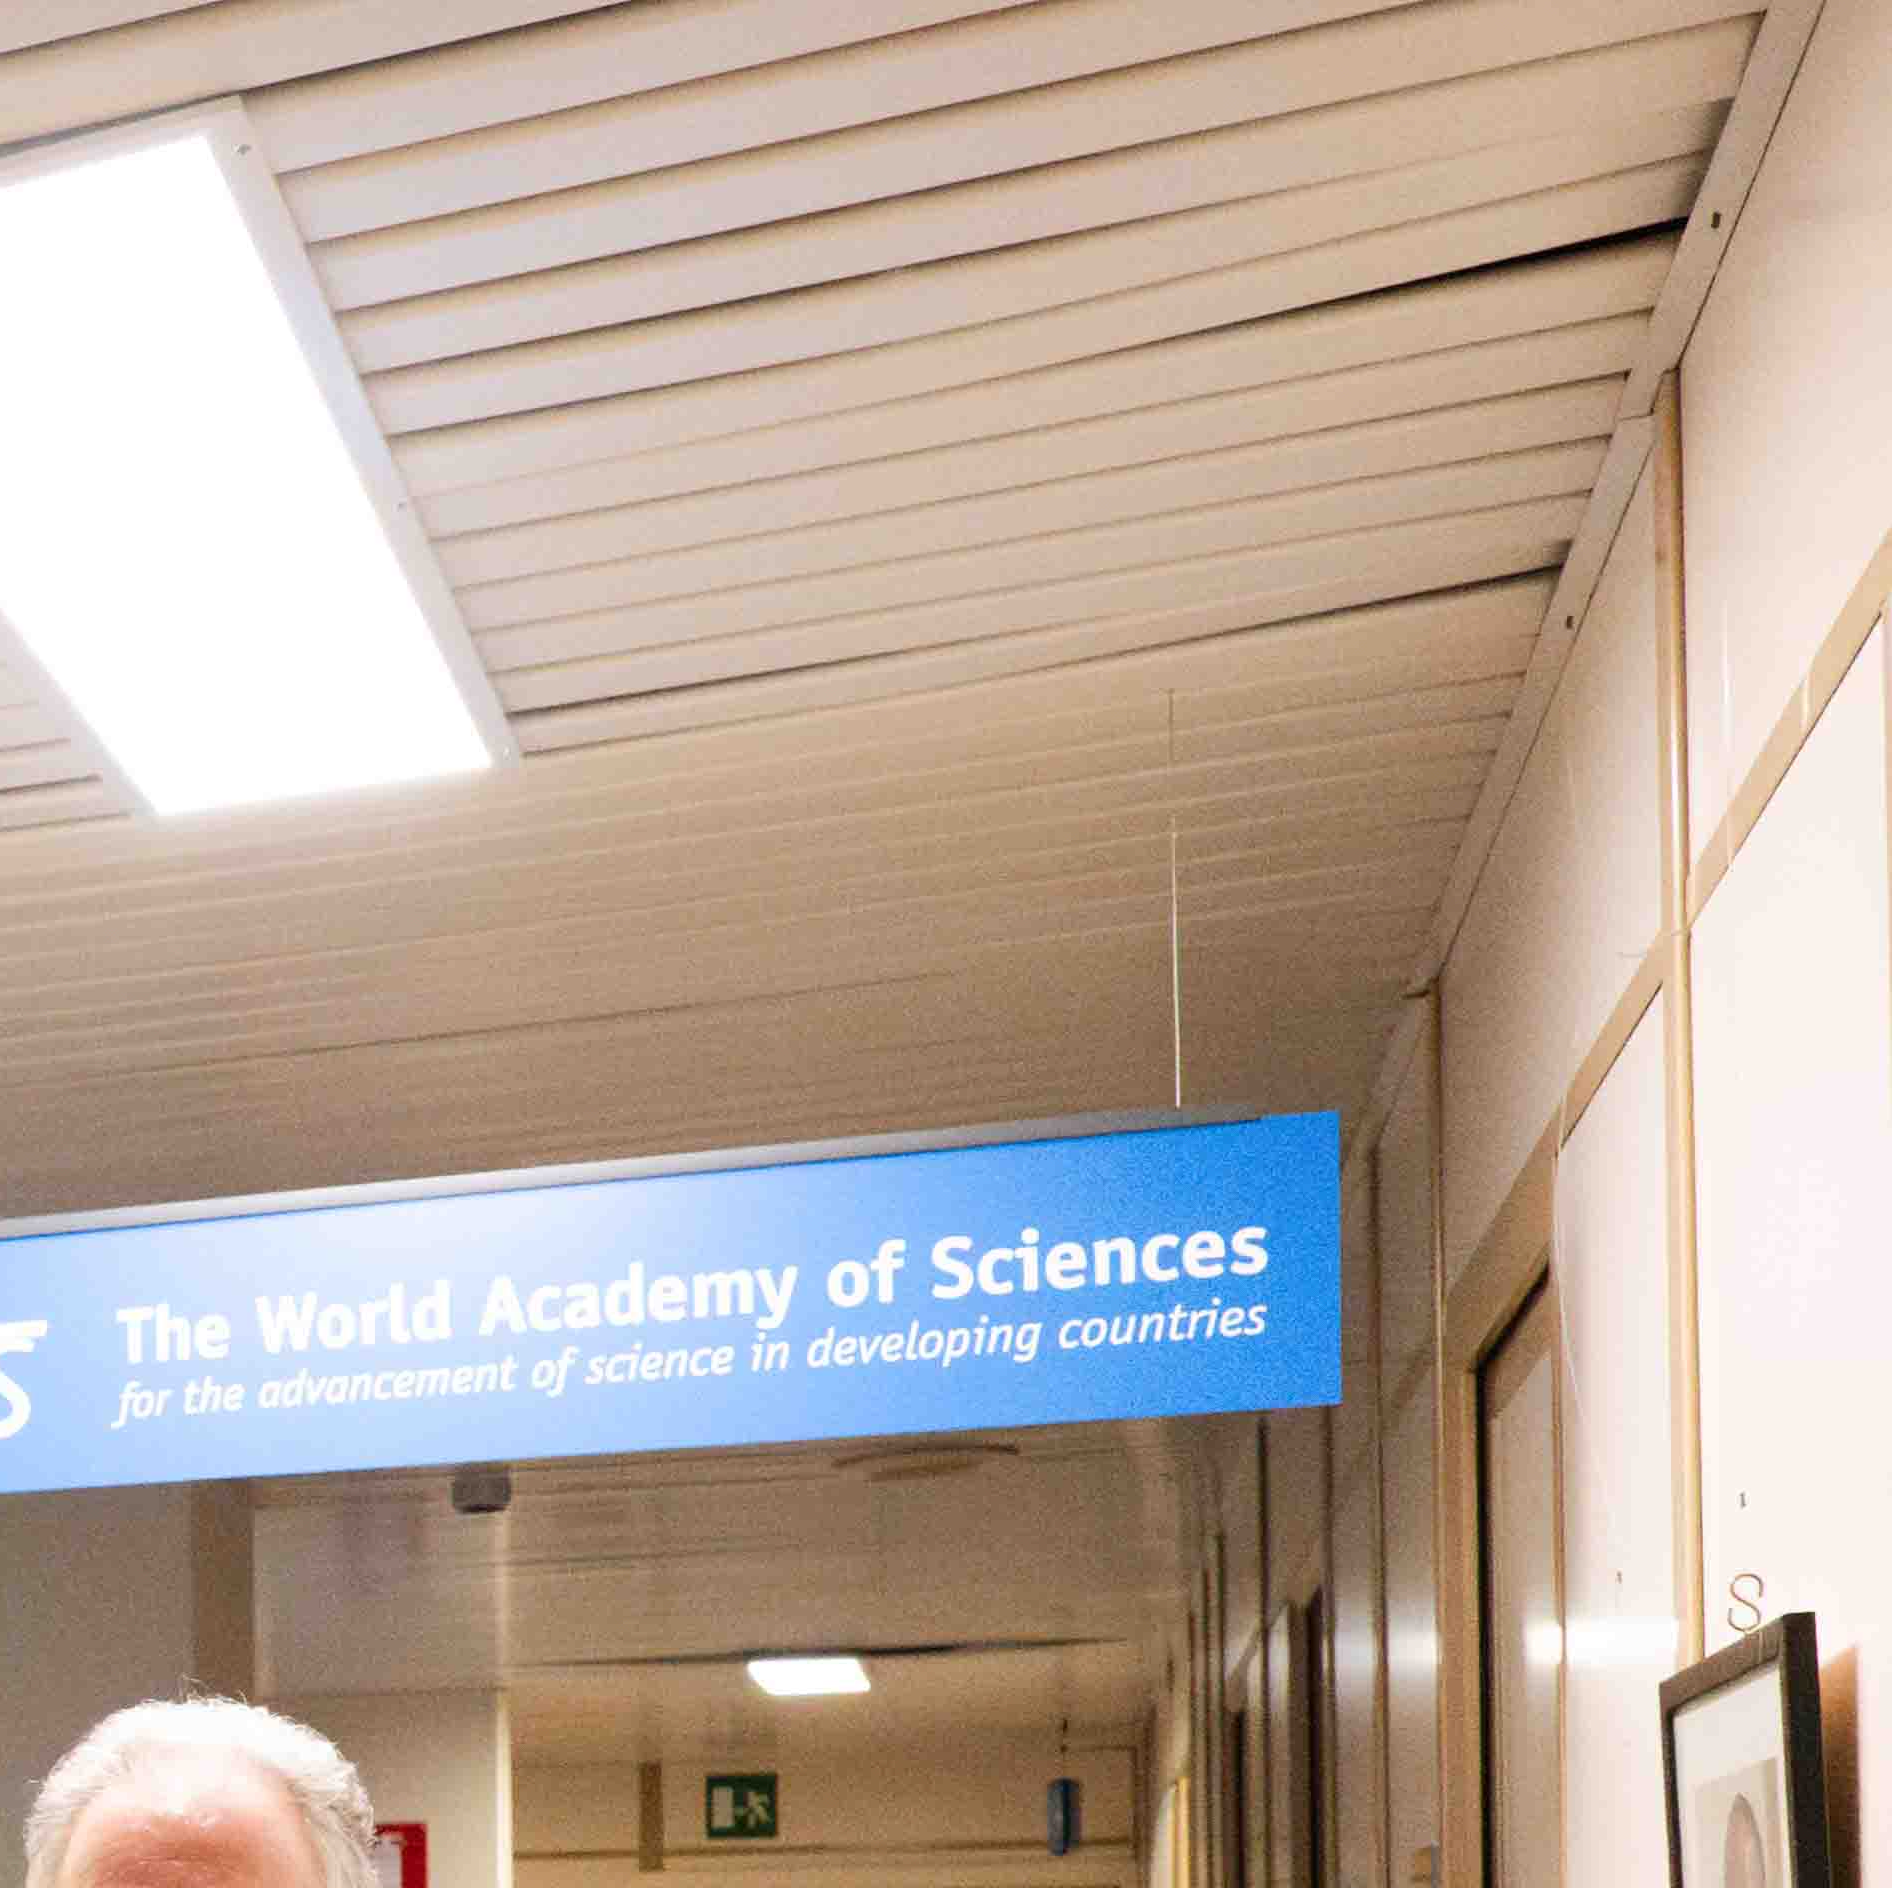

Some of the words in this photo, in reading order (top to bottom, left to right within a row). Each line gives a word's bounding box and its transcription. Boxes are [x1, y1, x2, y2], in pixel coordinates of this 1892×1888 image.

[115, 1303, 232, 1364] The
[255, 1279, 452, 1354] World
[478, 1260, 798, 1338] Academy
[826, 1239, 906, 1309] of
[930, 1225, 1269, 1299] Sciences
[110, 1381, 175, 1430] for
[183, 1377, 244, 1416] the
[257, 1357, 517, 1411] advancement
[530, 1350, 586, 1397] of
[584, 1343, 734, 1386] science
[750, 1331, 790, 1373] in
[805, 1314, 1041, 1369] developing
[1058, 1296, 1267, 1350] countries
